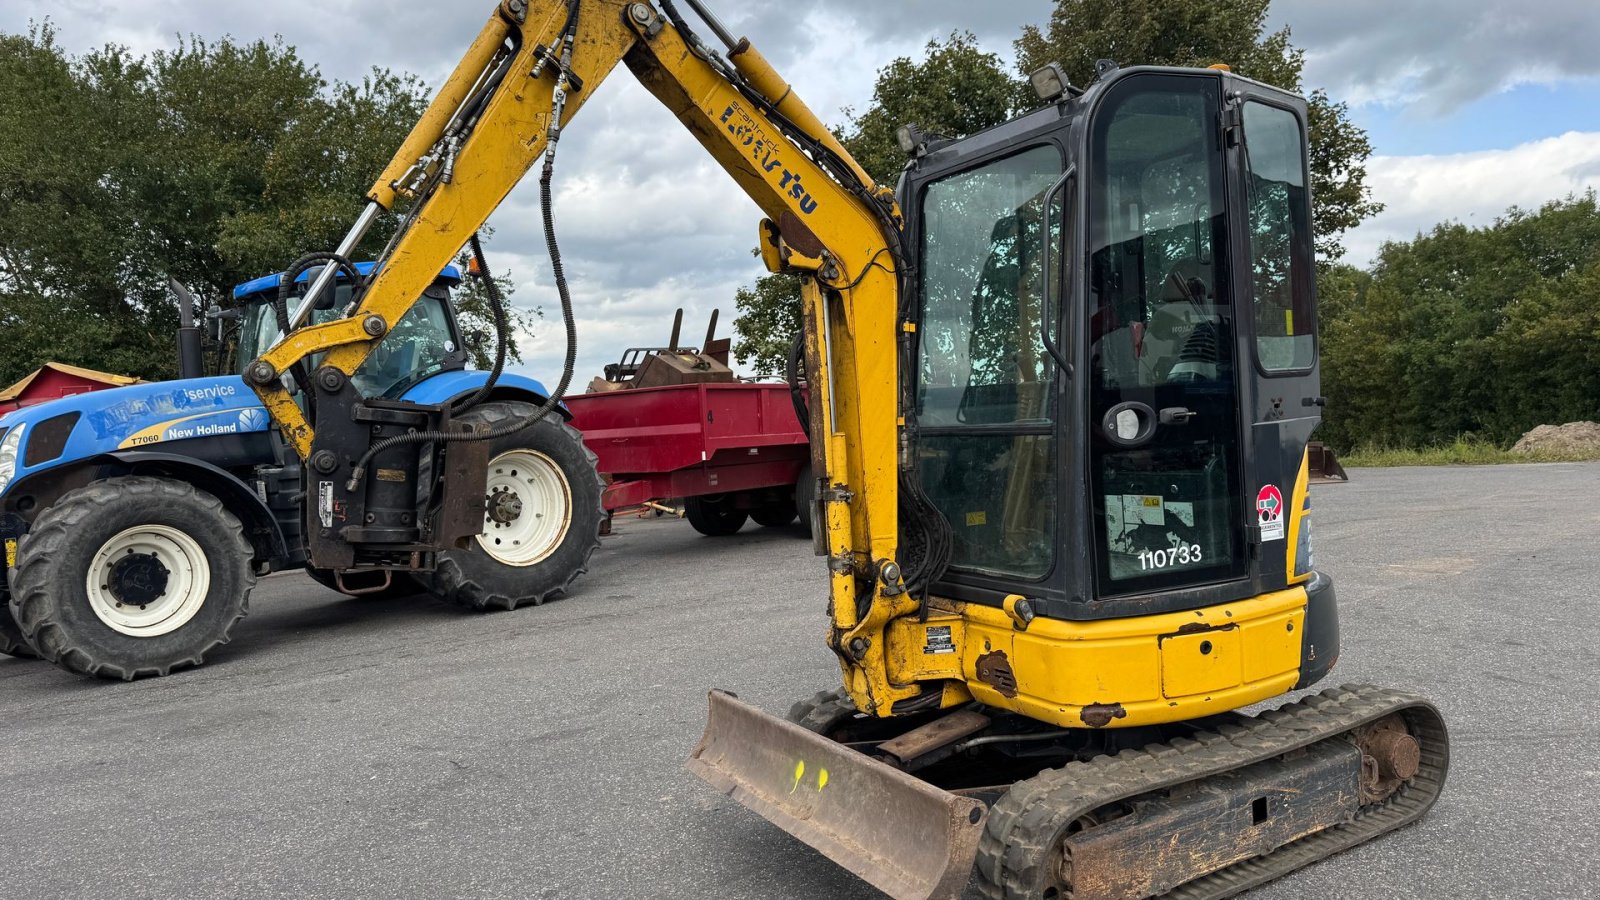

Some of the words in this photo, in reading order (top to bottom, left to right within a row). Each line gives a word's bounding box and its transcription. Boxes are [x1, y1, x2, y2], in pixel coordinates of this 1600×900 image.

[732, 101, 780, 155] scantruck
[131, 435, 159, 445] T7060
[168, 429, 194, 440] New
[197, 422, 237, 436] Holland
[1138, 544, 1202, 570] 110733
